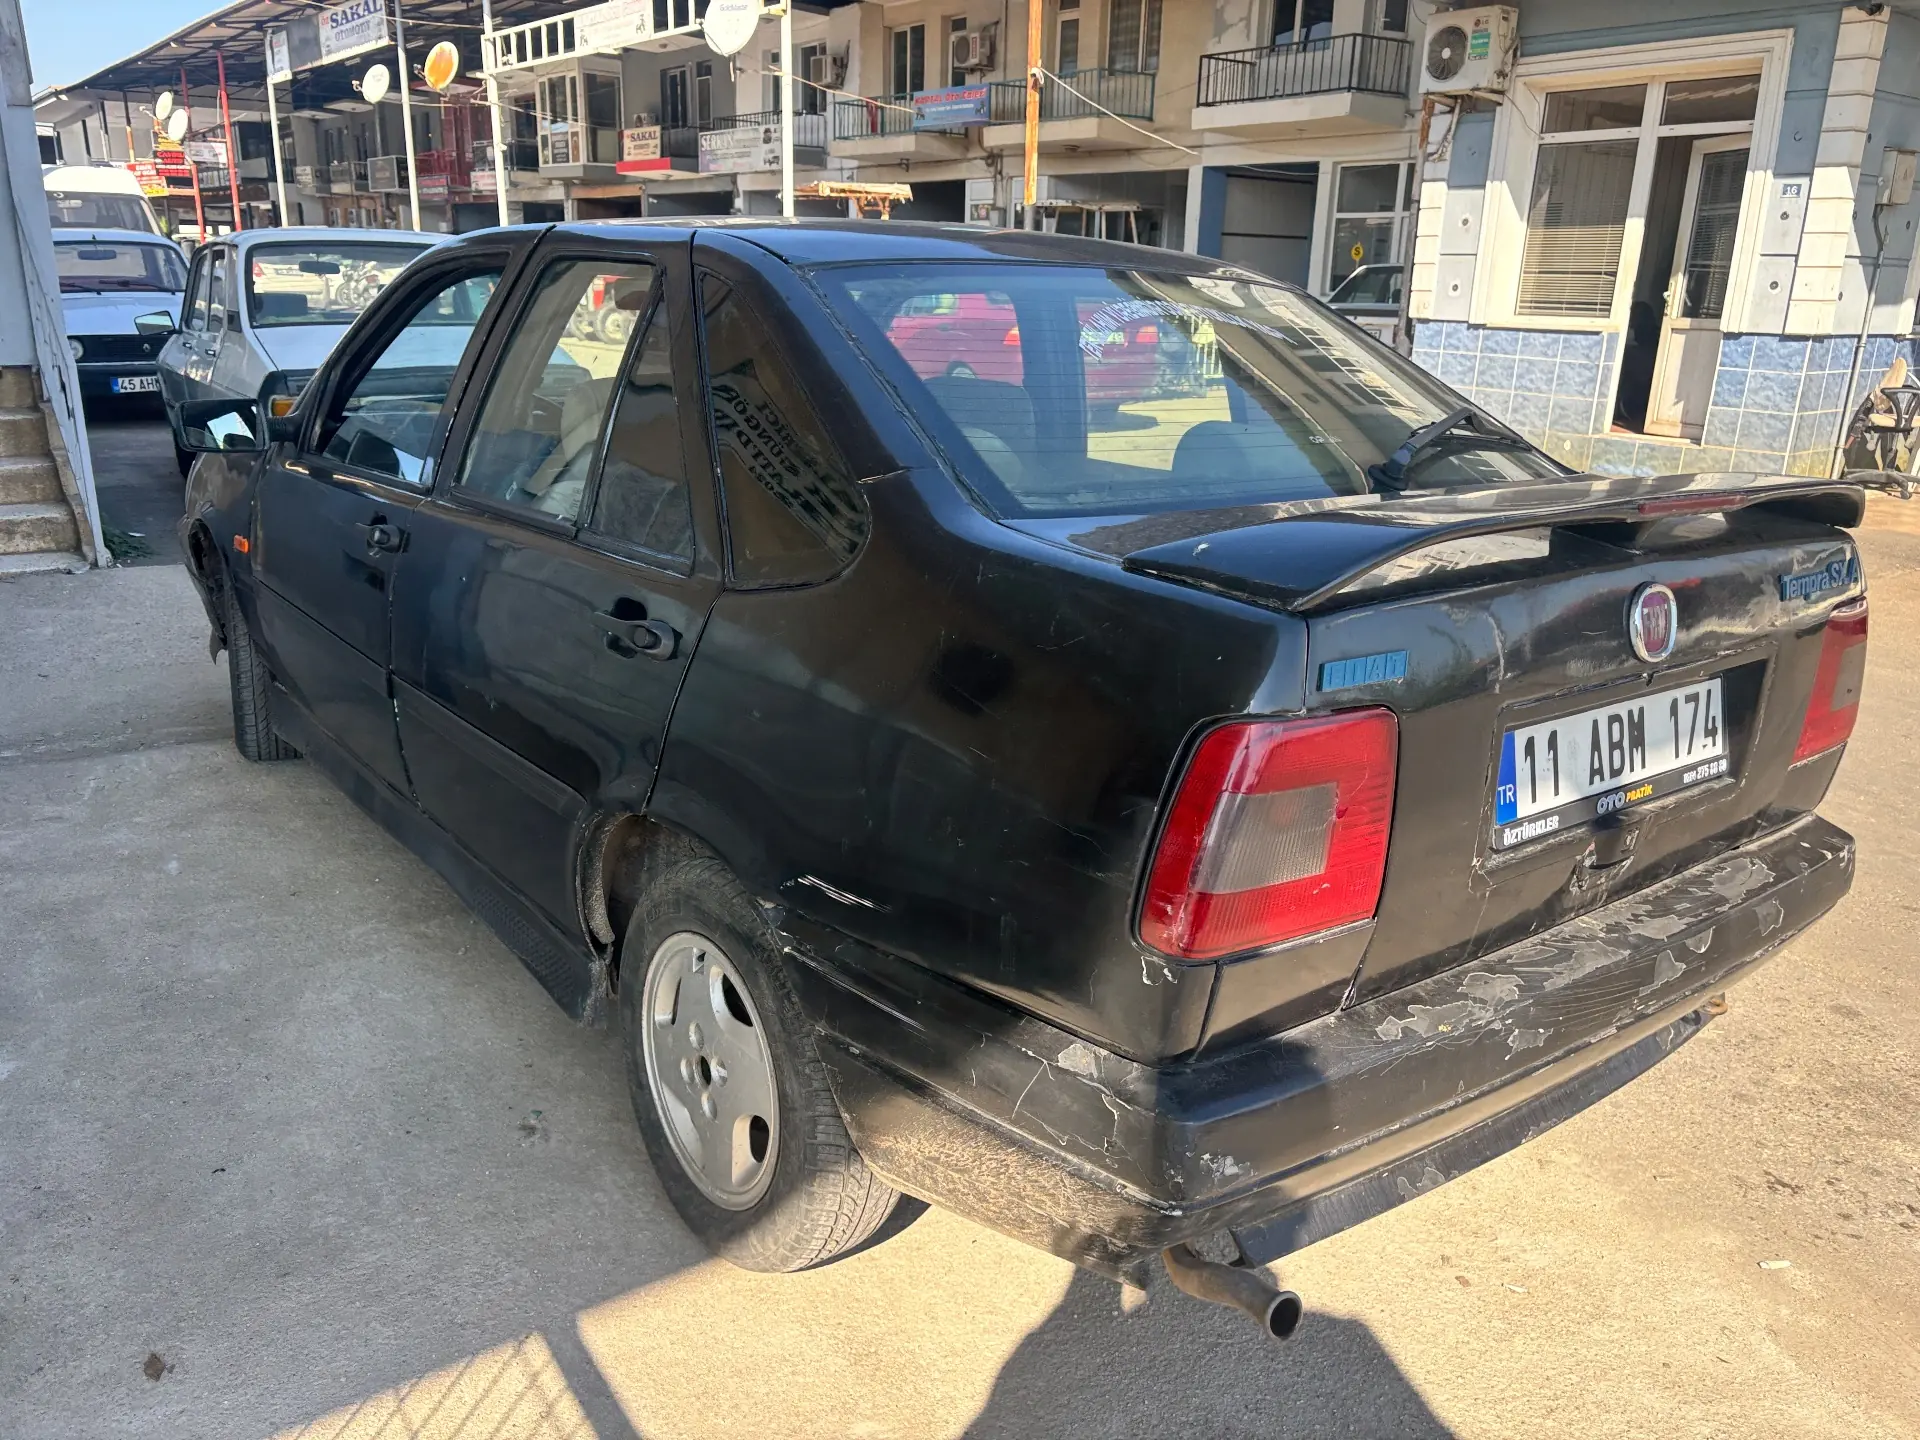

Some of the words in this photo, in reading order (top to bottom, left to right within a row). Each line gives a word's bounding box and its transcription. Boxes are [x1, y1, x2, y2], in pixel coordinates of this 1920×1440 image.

[330, 0, 383, 29] SAKAL
[630, 130, 659, 143] SAKAL
[1785, 185, 1798, 196] 16
[120, 378, 136, 391] 45
[1782, 571, 1831, 601] Tempra
[1498, 783, 1515, 806] TR
[1524, 729, 1560, 804] 11
[1588, 706, 1647, 786] ABM
[1669, 688, 1718, 760] 174
[1596, 791, 1626, 815] OTO
[1626, 783, 1653, 803] PRATİK
[1503, 815, 1560, 847] ÖZTÜRKLER
